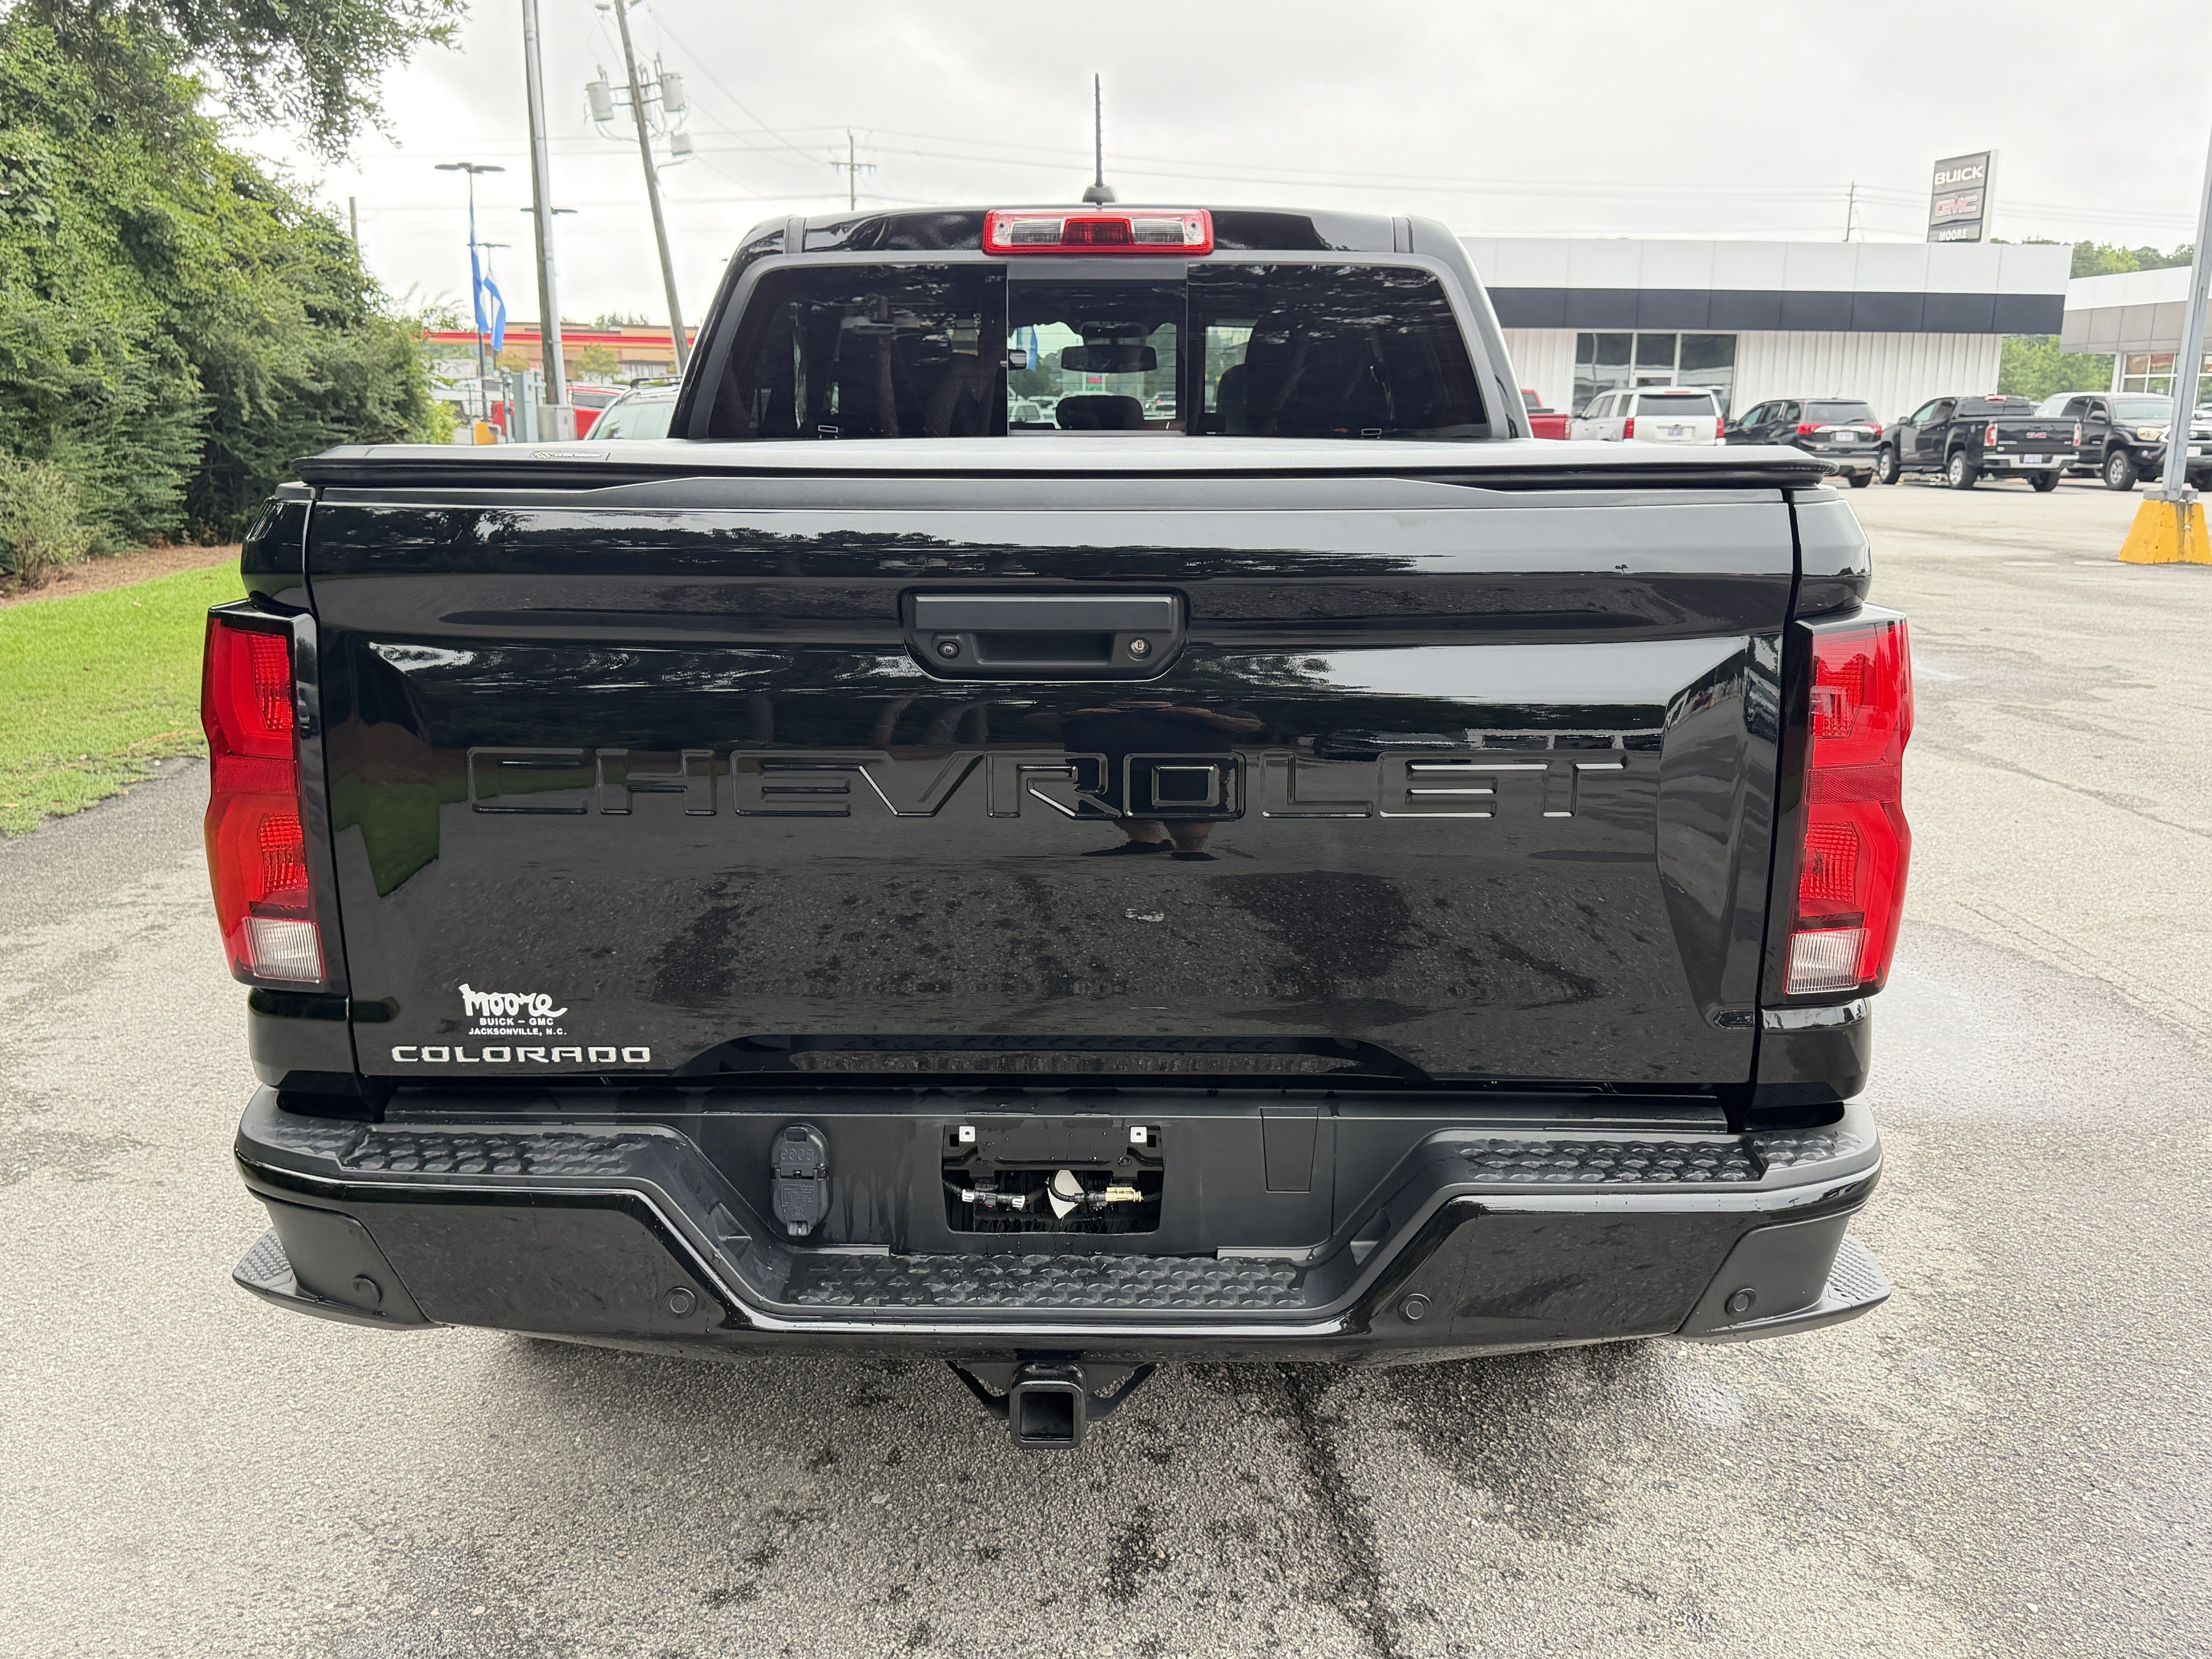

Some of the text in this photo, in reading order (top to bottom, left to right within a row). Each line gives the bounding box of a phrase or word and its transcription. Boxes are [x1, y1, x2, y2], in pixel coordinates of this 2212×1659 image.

[1934, 165, 1984, 185] BUICK
[1934, 195, 1978, 217] GMC
[1938, 228, 1968, 241] MOORE
[467, 748, 1627, 818] CHEVROLET
[479, 1017, 515, 1026] BUICK
[529, 1017, 554, 1026] GMC
[468, 1027, 542, 1036] JACKSONVILLE,
[392, 1046, 651, 1063] COLORADO
